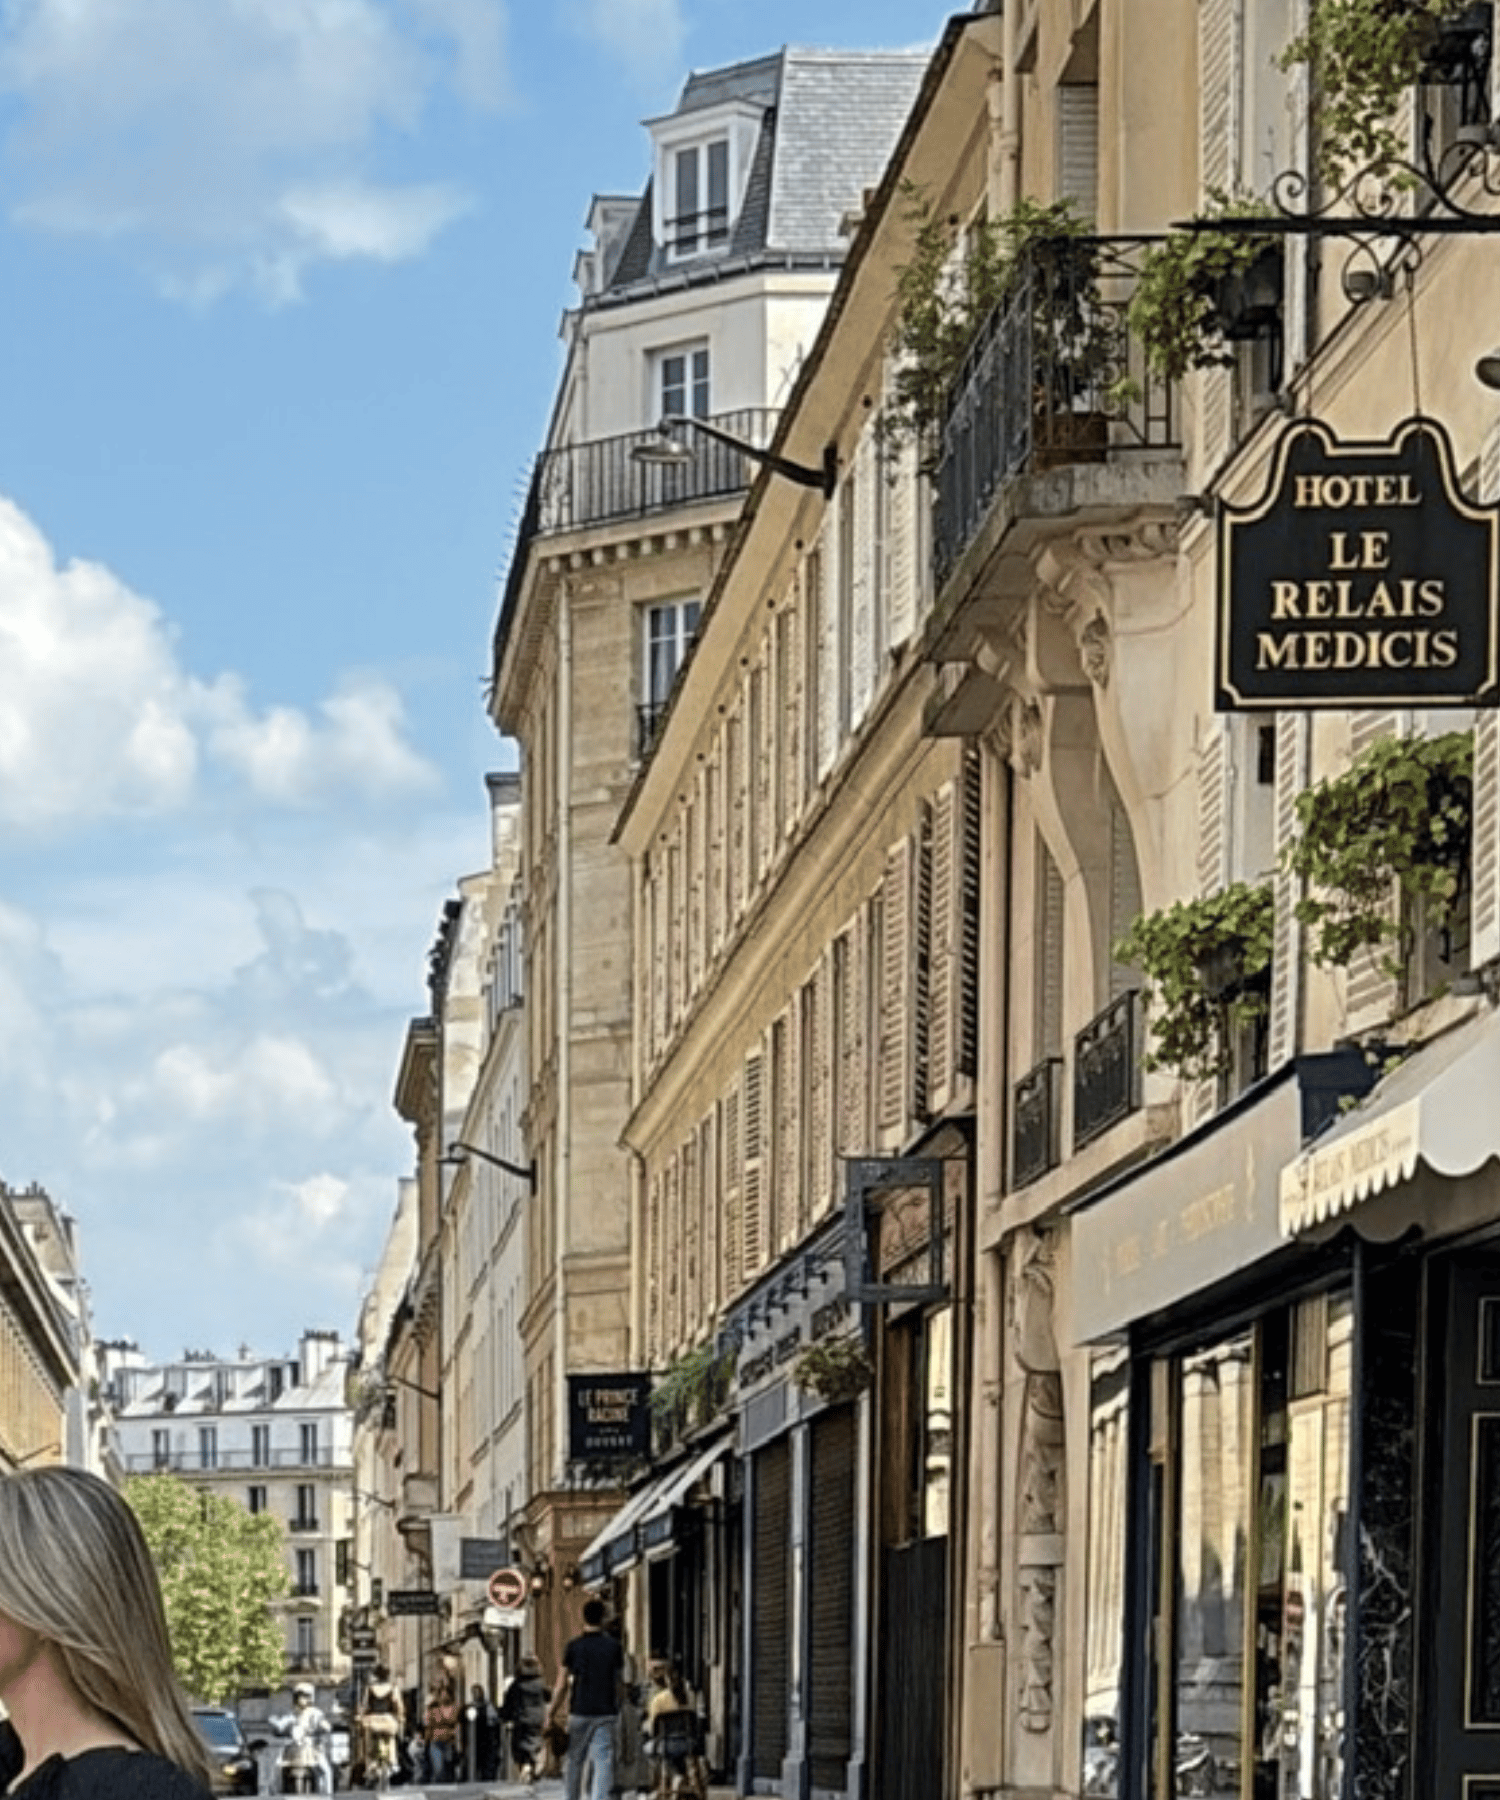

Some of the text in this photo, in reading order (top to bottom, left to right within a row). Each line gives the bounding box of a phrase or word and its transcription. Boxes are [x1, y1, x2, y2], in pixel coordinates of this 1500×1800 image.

[1295, 475, 1421, 508] HOTEL
[1329, 531, 1390, 570] LE
[1271, 580, 1445, 619] RELAIS
[1256, 631, 1458, 670] MEDICIS
